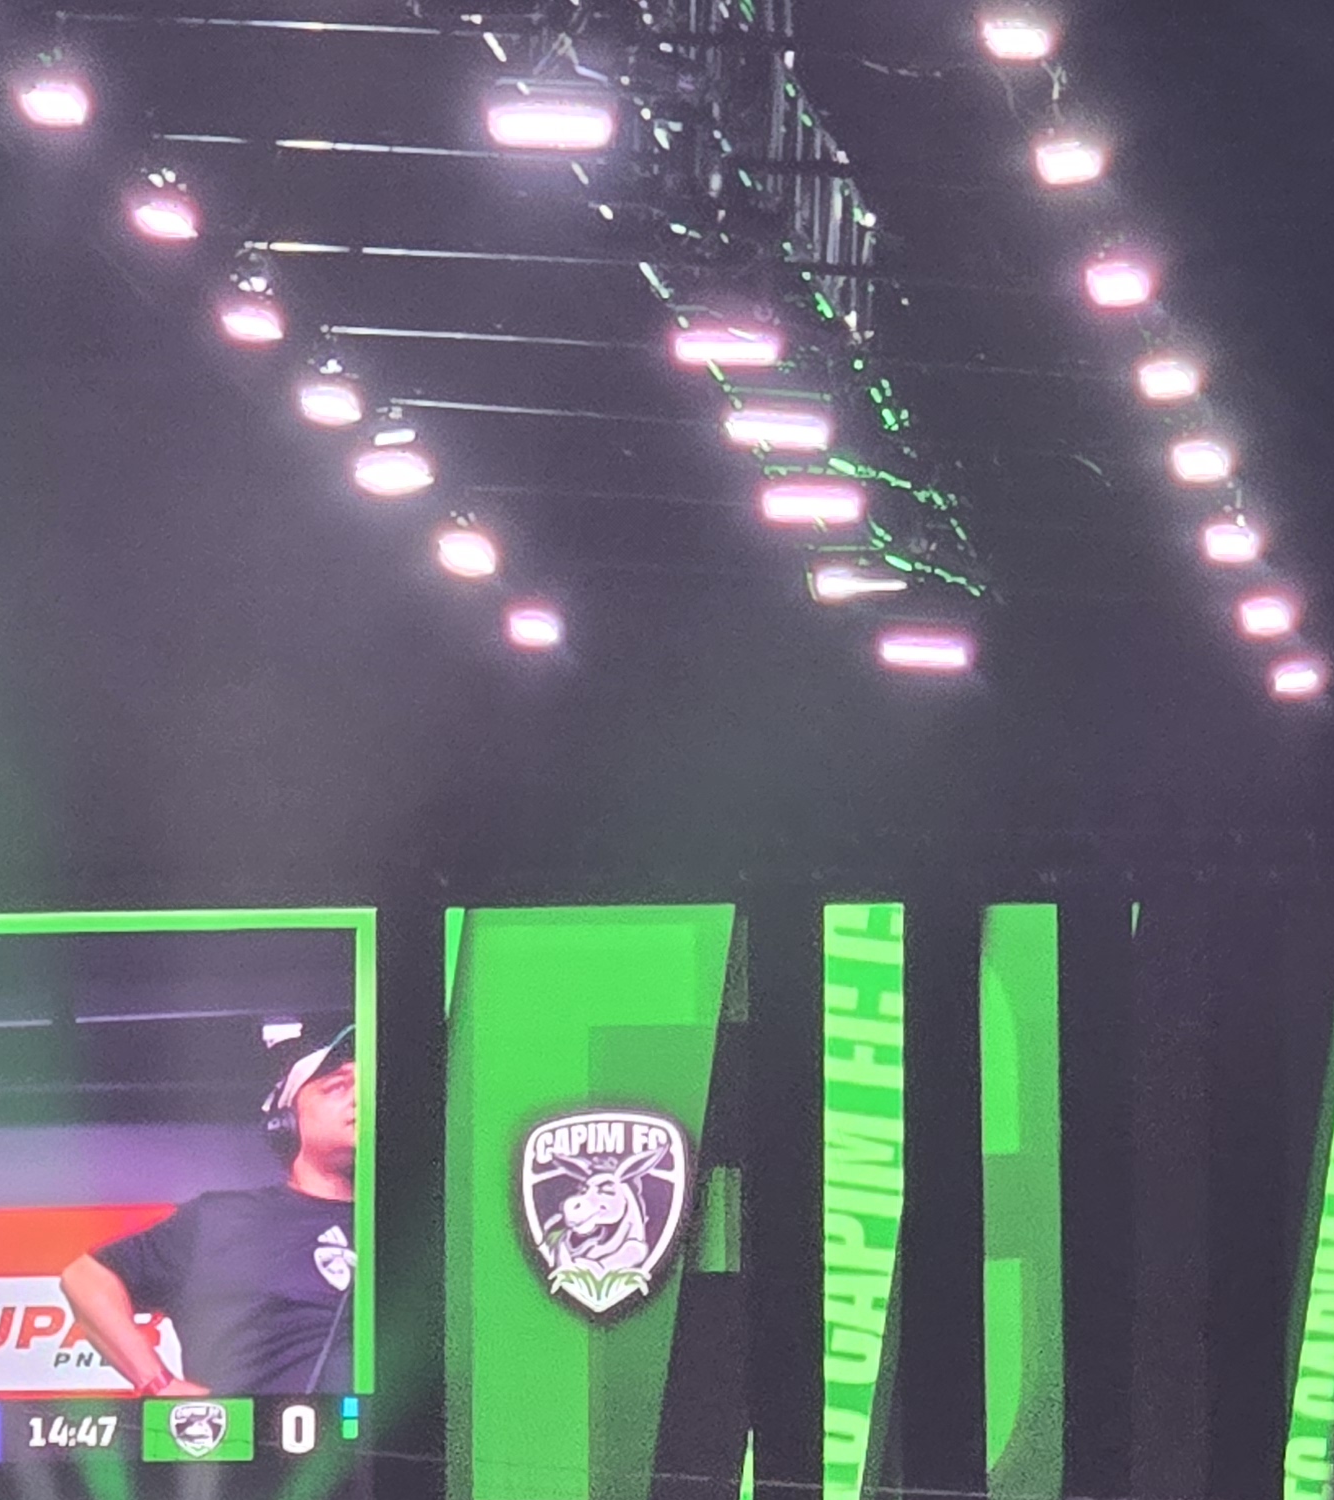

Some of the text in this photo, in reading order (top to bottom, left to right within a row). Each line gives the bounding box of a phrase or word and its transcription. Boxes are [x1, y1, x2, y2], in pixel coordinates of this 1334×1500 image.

[535, 1122, 667, 1164] CAPIM FC
[28, 1415, 117, 1447] 14:47
[281, 1404, 316, 1454] 0
